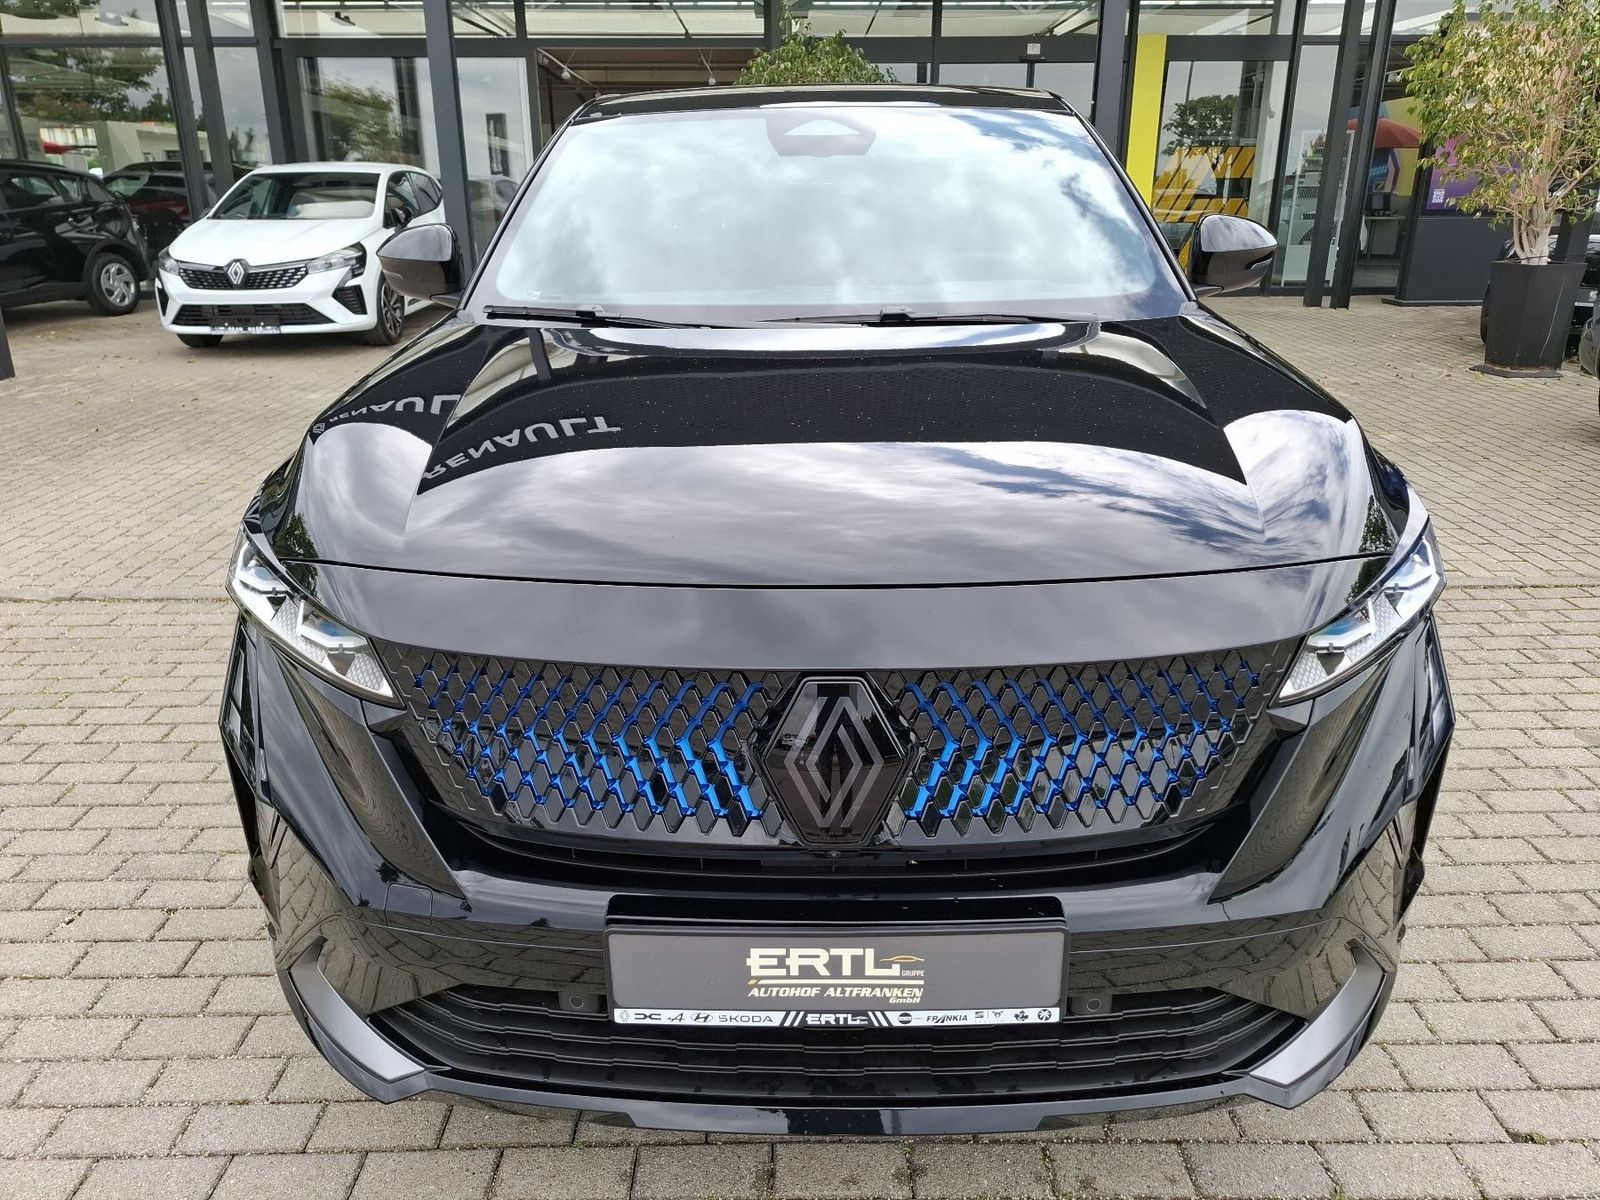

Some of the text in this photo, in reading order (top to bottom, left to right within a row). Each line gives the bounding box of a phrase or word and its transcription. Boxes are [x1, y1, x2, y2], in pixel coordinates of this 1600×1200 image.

[746, 948, 900, 976] ERTL
[748, 987, 923, 997] AUTOHOF ALTFRANKEN
[889, 996, 921, 1004] GmbH
[806, 1013, 868, 1025] ERTL
[926, 1014, 968, 1024] FRANKIA
